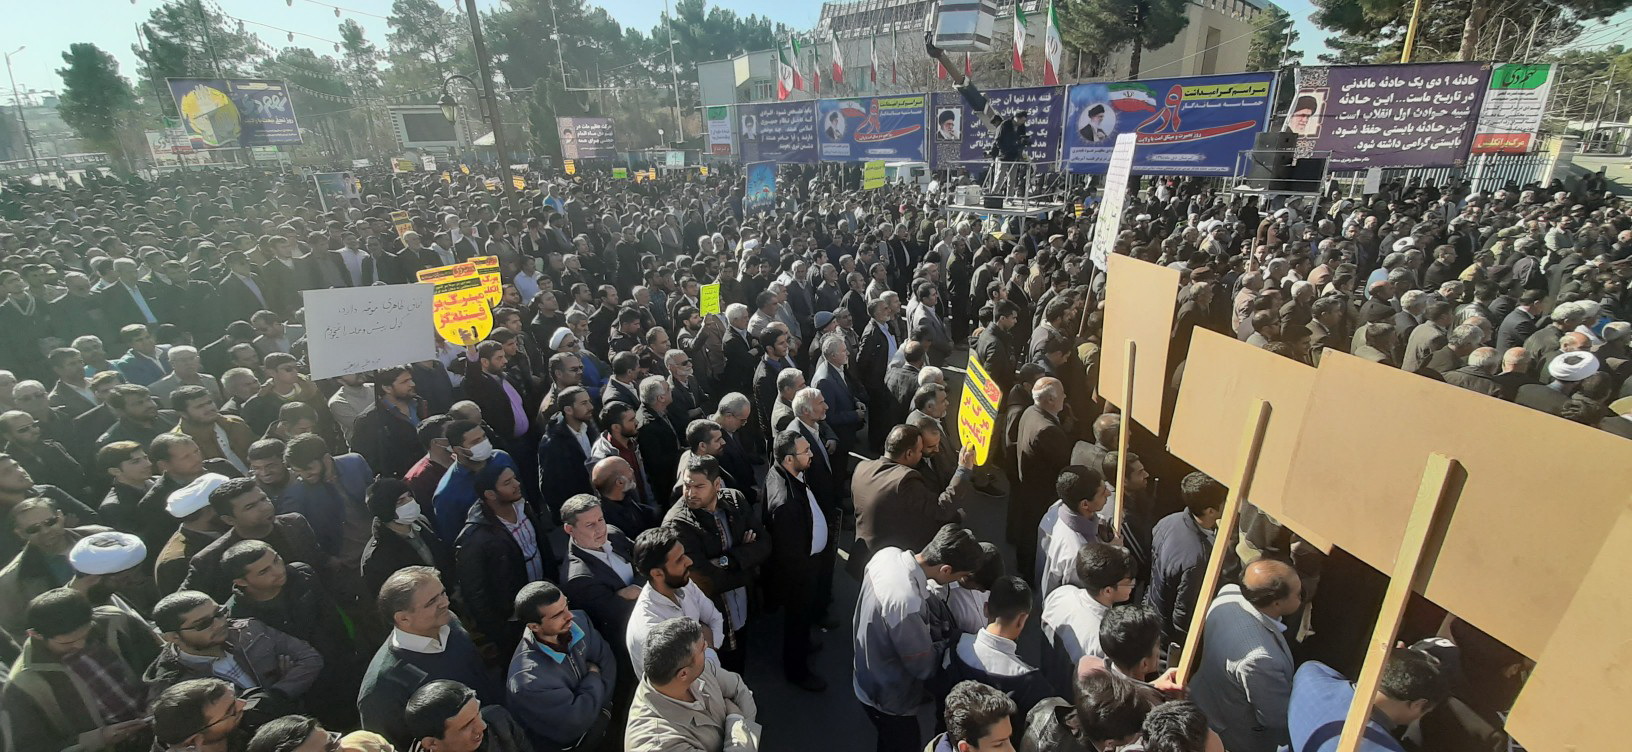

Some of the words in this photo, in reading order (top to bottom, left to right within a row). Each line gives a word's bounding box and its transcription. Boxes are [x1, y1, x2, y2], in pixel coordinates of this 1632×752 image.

[1342, 78, 1376, 92] ماندنی
[1379, 76, 1406, 88] حادثه
[1408, 76, 1423, 89] یک
[1426, 77, 1441, 88] دی
[1444, 76, 1450, 86] ۹
[1452, 73, 1479, 86] حادثه
[1232, 86, 1266, 96] مراسم
[1004, 94, 1012, 105] آن
[1339, 92, 1370, 104] حادثه
[1373, 93, 1394, 106] این
[1433, 91, 1461, 104] تاریخ
[1461, 92, 1475, 104] در
[1363, 108, 1392, 120] انقلاب
[1394, 108, 1411, 120] اول
[1413, 107, 1448, 120] حوادث
[1024, 117, 1049, 127] تعدادی
[1416, 122, 1444, 132] حادثه
[1446, 121, 1467, 134] این
[1037, 128, 1048, 137] یک
[1360, 124, 1381, 134] حفظ
[1383, 123, 1414, 136] بایستی
[1377, 139, 1401, 148] داشته
[1402, 136, 1431, 150] گرامی
[1430, 137, 1461, 149] بایستی
[961, 415, 985, 448] انگلیس
